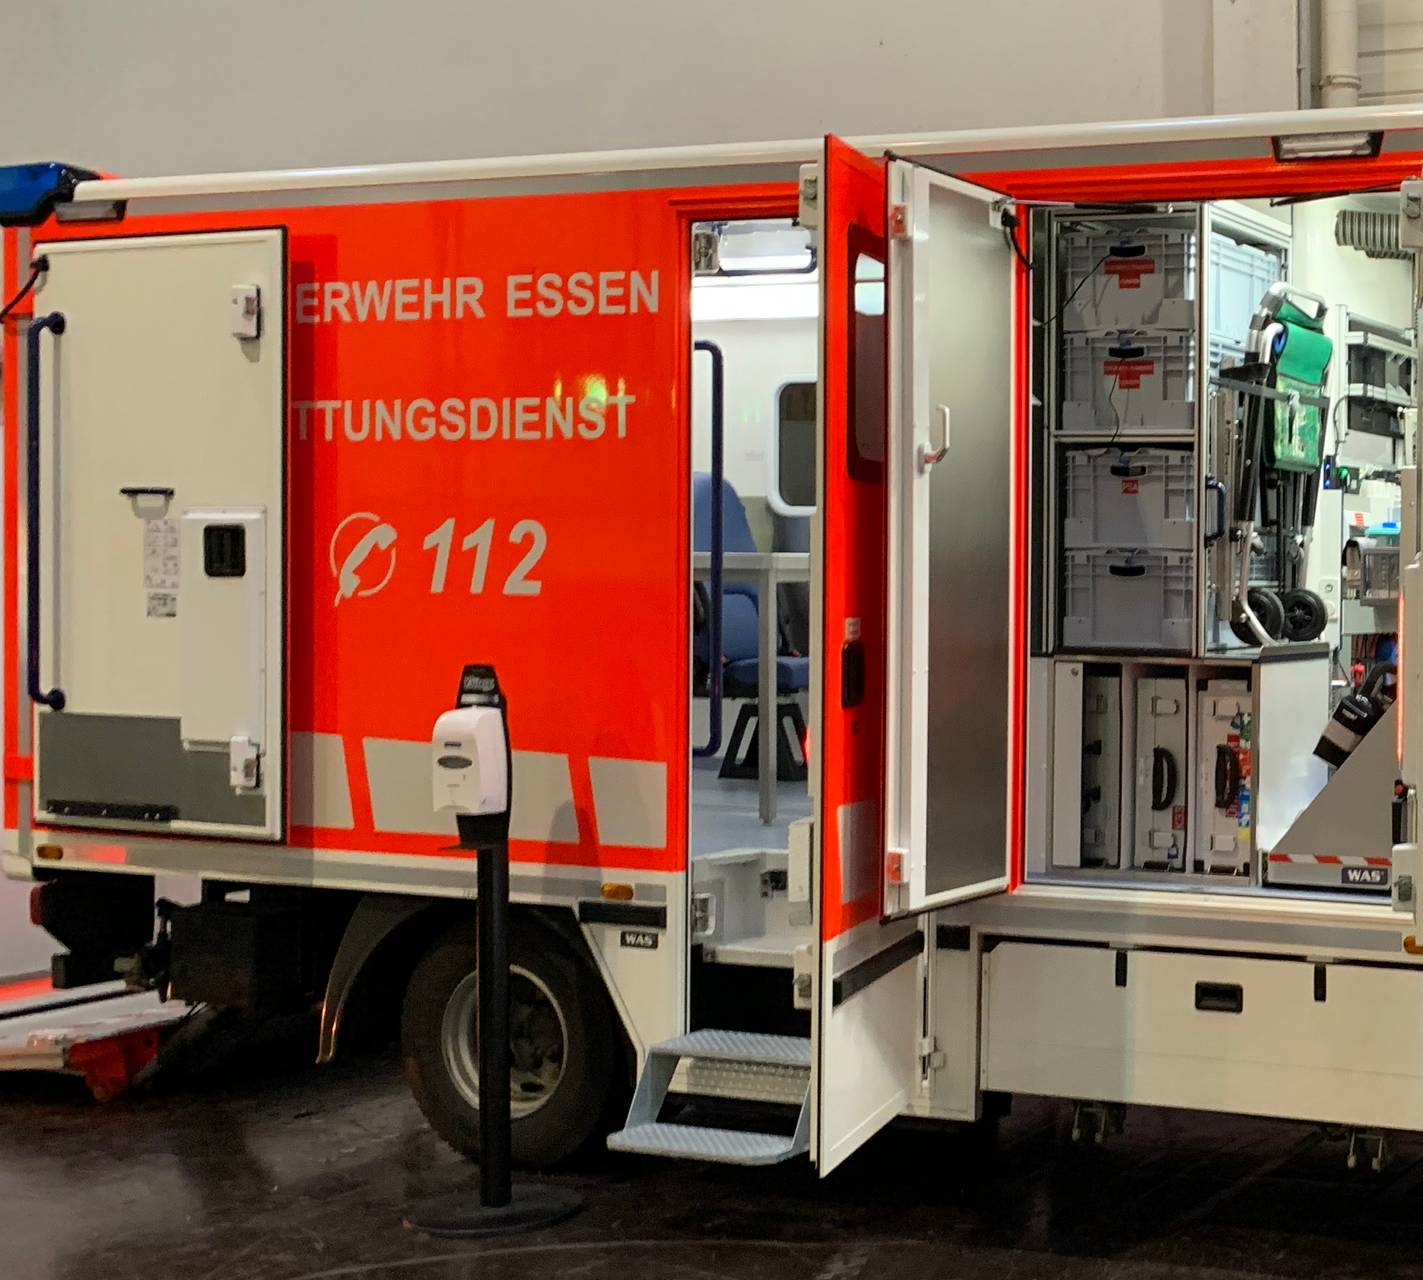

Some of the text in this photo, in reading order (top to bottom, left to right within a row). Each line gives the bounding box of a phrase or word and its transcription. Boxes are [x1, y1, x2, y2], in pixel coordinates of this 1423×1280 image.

[295, 270, 659, 323] ERWEHR ESSEN
[292, 395, 636, 441] TTUNGSDIENST
[423, 517, 547, 596] 112
[625, 933, 653, 946] WAS
